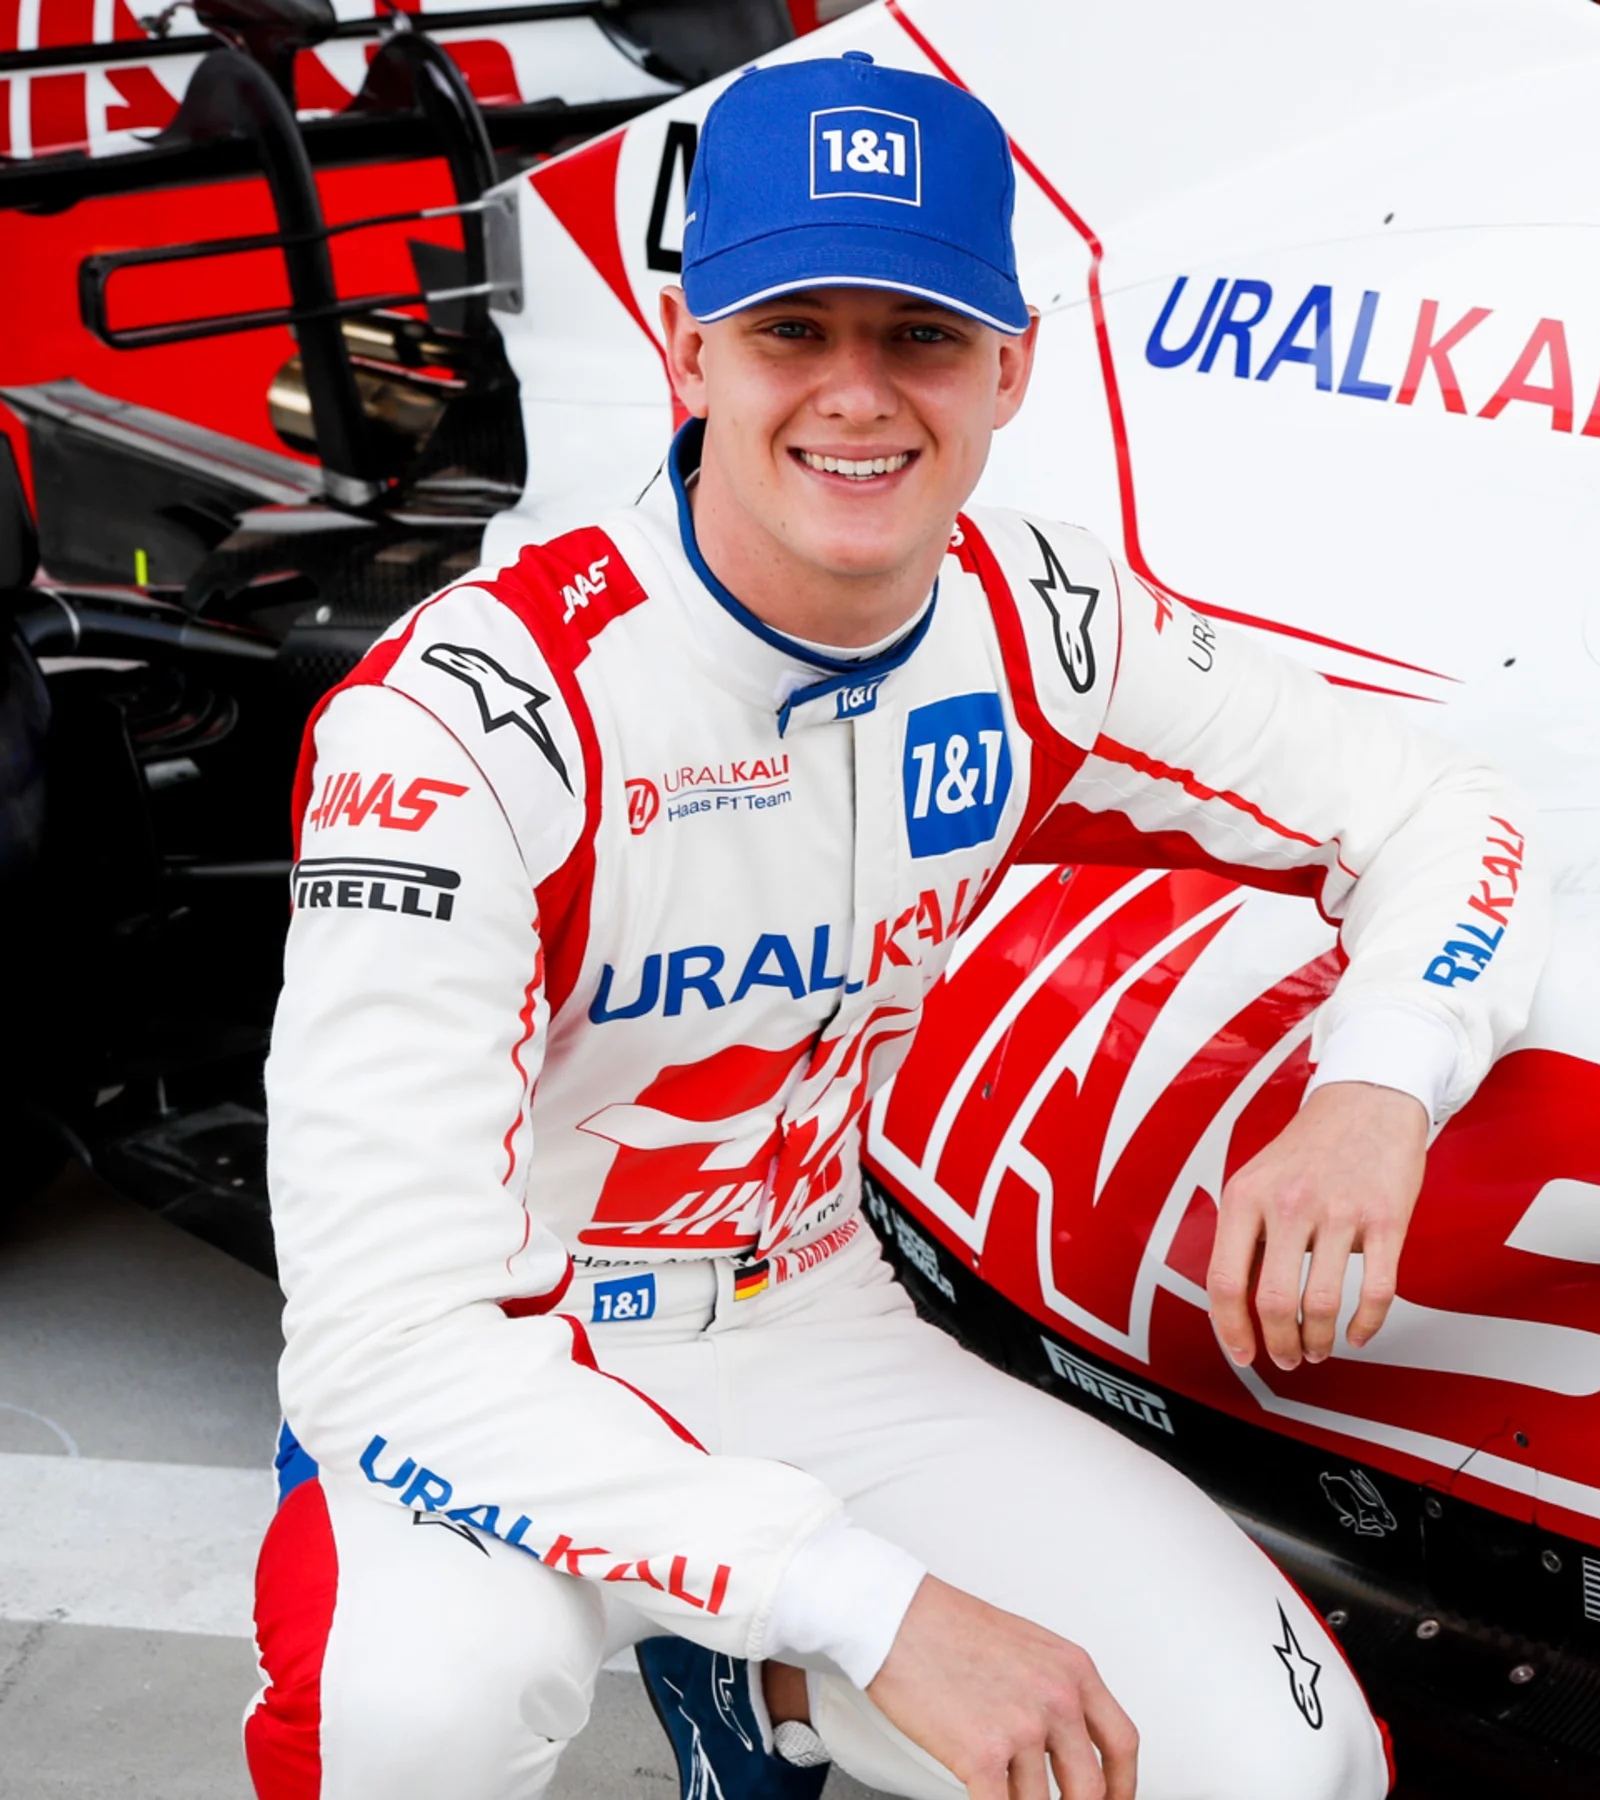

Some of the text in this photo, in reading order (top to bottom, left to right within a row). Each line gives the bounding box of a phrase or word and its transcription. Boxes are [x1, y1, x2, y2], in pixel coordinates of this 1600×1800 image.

[822, 129, 906, 177] 1&1
[841, 682, 879, 713] 1&1
[664, 753, 790, 793] URALKALI
[911, 729, 1004, 820] 1&1
[310, 772, 471, 833] HAAS
[667, 799, 712, 823] Haas
[744, 789, 793, 811] Team
[1422, 814, 1525, 988] RALKALI
[599, 1288, 650, 1321] 1&1
[1039, 1334, 1176, 1436] PIRELLI
[359, 1433, 733, 1616] URALKALI
